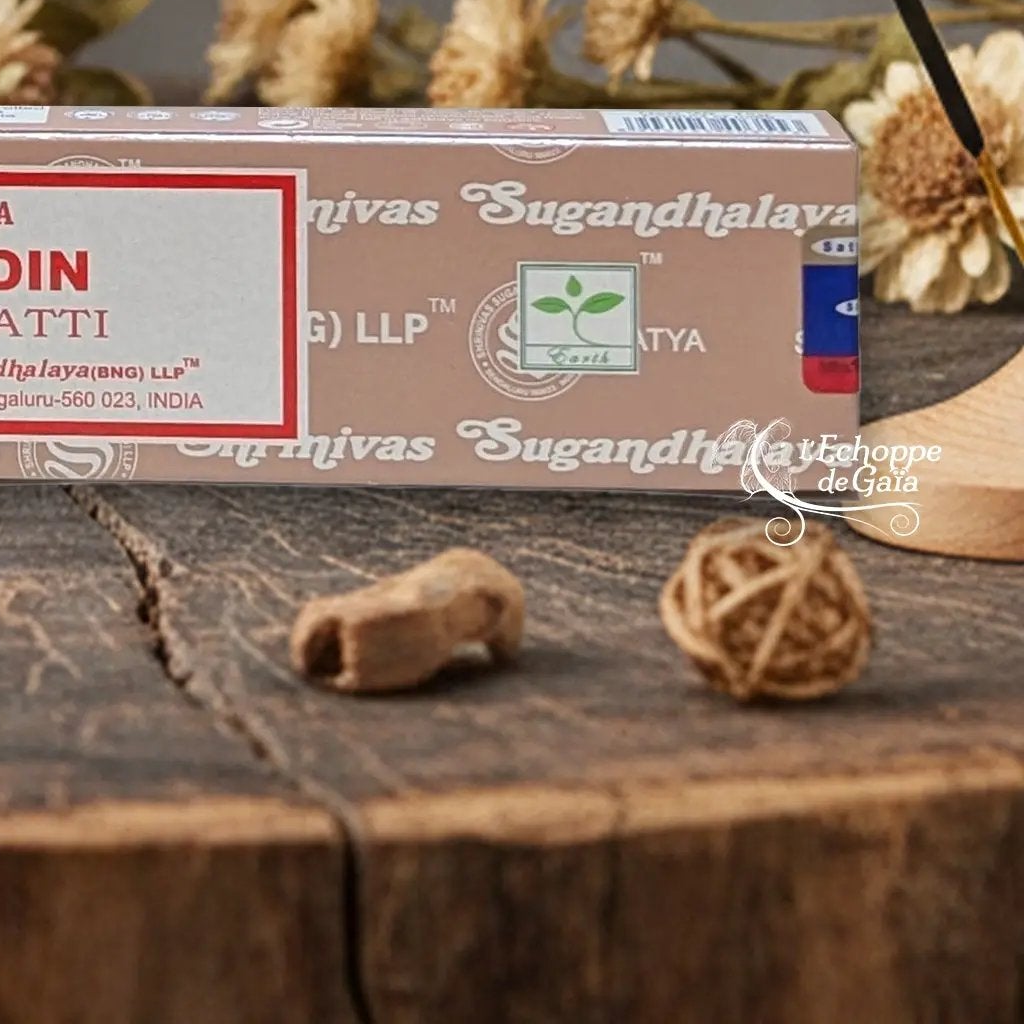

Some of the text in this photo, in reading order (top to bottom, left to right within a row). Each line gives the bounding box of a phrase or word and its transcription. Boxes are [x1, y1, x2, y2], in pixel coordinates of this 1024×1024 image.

[307, 190, 439, 235] nivas
[823, 240, 856, 253] Sat
[636, 327, 707, 353] ATYA
[102, 391, 141, 410] 023,
[148, 392, 204, 409] INDIA
